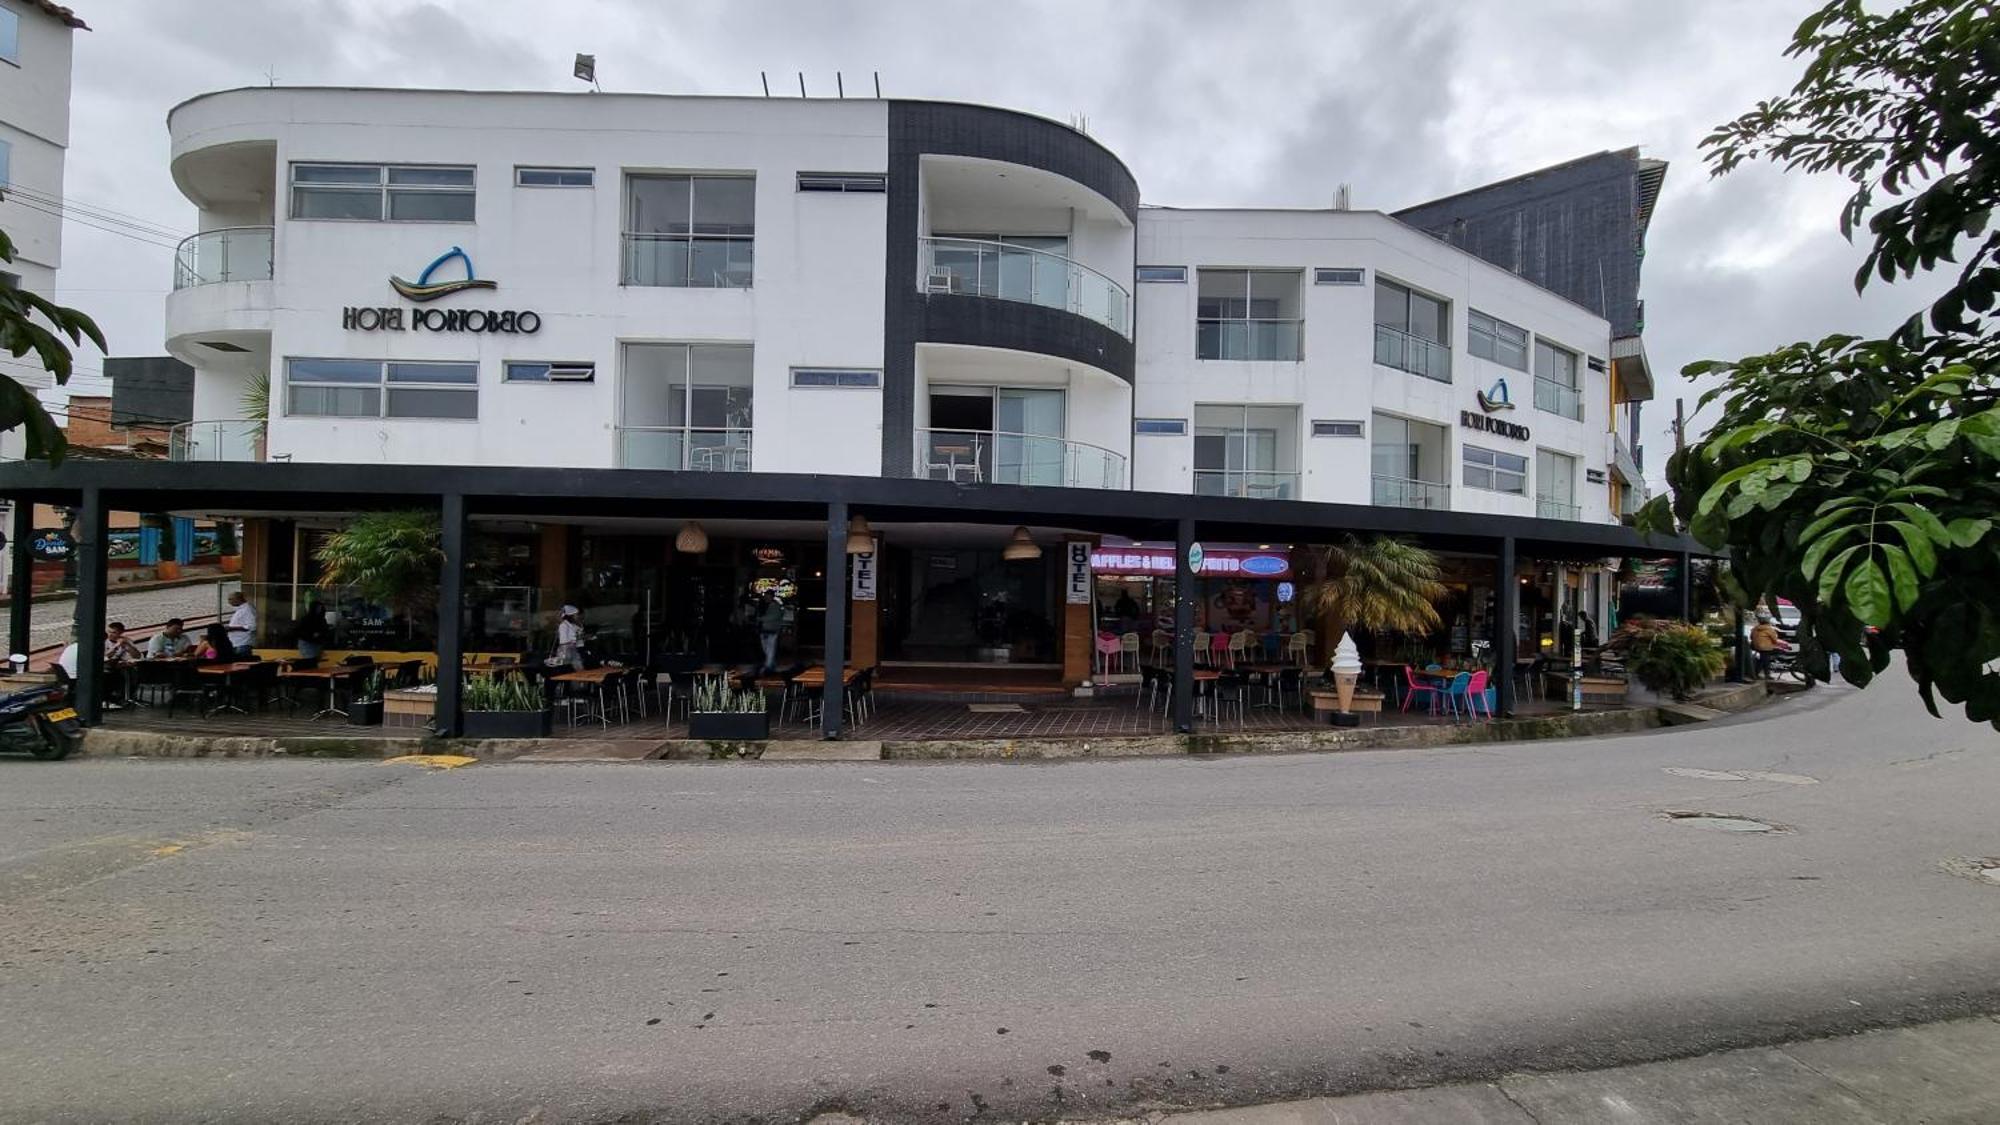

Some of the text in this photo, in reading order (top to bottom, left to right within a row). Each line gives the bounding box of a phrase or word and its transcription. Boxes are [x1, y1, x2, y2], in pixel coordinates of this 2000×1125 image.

[342, 306, 541, 334] HOTEL PORTOBELO
[1072, 544, 1088, 593] HOTEL
[1090, 554, 1142, 568] AFFLES
